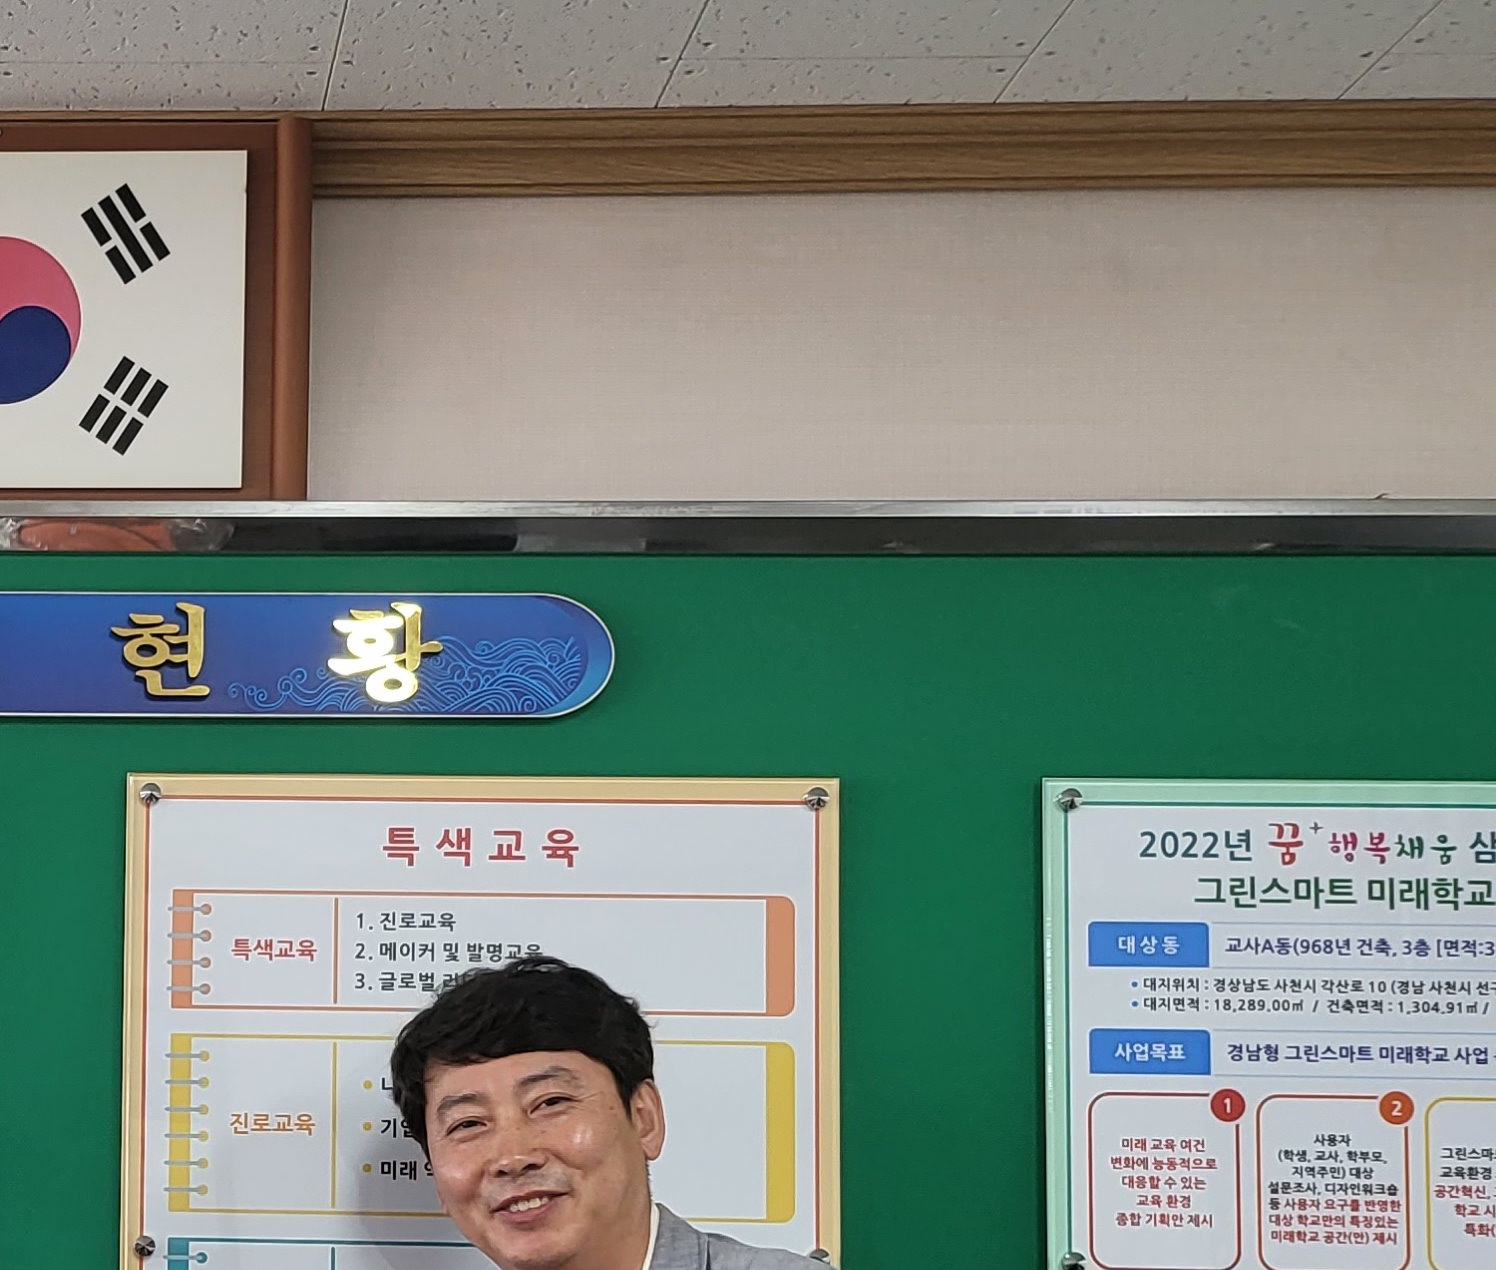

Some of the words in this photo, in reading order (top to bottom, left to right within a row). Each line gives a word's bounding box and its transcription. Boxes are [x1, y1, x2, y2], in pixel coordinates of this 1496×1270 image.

[382, 826, 580, 867] 특색교육
[1139, 830, 1253, 862] 2022년
[1194, 877, 1357, 909] 그린스마트
[380, 912, 456, 932] 진로교육
[231, 938, 317, 961] 특색교육
[379, 942, 435, 962] 메이커
[444, 943, 459, 962] 및
[1118, 936, 1180, 954] 대상동
[1357, 939, 1396, 957] 건축,
[1403, 940, 1430, 957] 3층
[379, 972, 435, 992] 글로벌
[1144, 978, 1200, 992] 대지위치
[1214, 978, 1270, 993] 경상남도
[1275, 979, 1316, 993] 사천시
[1321, 979, 1363, 994] 각산로
[1369, 981, 1385, 993] 10
[1391, 980, 1424, 995] (경남
[1429, 981, 1471, 995] 사천시
[1144, 998, 1200, 1012] 대지면적
[1327, 1000, 1382, 1014] 건축면적
[1115, 1043, 1186, 1061] 사업목표
[1227, 1043, 1279, 1062] 경남형
[1285, 1045, 1374, 1062] 그린스마트
[1379, 1046, 1450, 1064] 미래학교
[1455, 1048, 1488, 1064] 사업
[1224, 1098, 1231, 1113] 1
[1391, 1101, 1402, 1116] 2
[230, 1112, 316, 1135] 진로교육
[1122, 1138, 1146, 1151] 미래
[1151, 1139, 1176, 1151] 교육
[1180, 1139, 1205, 1152] 여건
[1314, 1134, 1351, 1147] 사용자
[1111, 1157, 1148, 1170] 변화에
[1152, 1158, 1217, 1170] 능동적으로
[1278, 1150, 1311, 1163] (학생,
[381, 1161, 417, 1180] 미래
[1292, 1167, 1346, 1179] 지역주민)
[1122, 1176, 1161, 1189] 대응할
[1164, 1177, 1177, 1189] 수
[1180, 1177, 1206, 1190] 있는
[1146, 1214, 1183, 1227] 기획안
[1187, 1214, 1212, 1228] 제시
